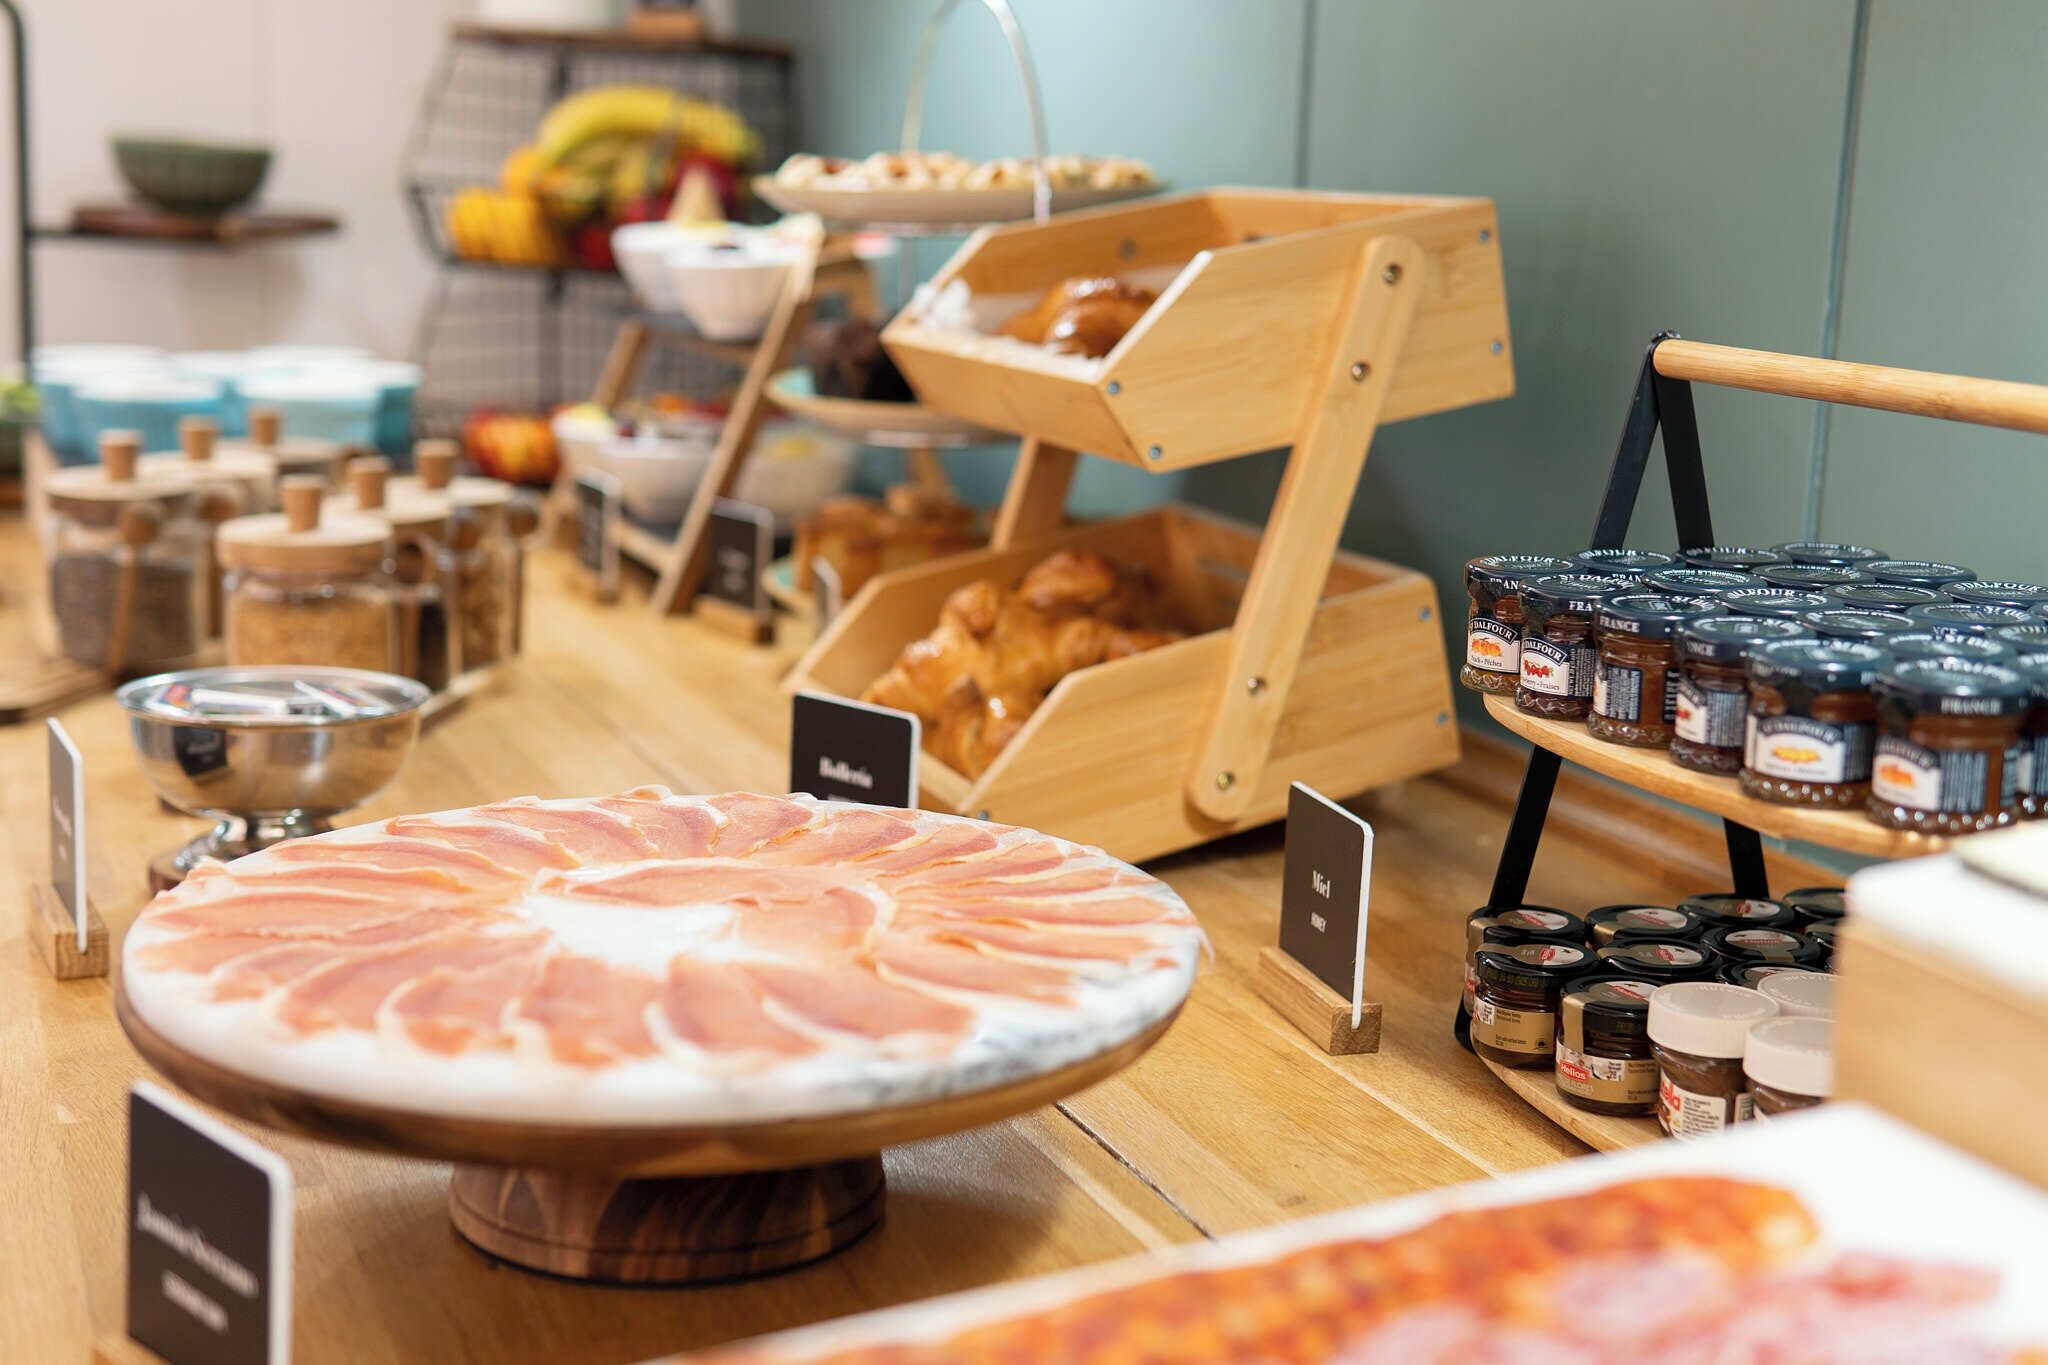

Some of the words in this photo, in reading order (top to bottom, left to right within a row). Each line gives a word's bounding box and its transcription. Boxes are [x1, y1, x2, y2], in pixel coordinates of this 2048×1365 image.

[1473, 620, 1513, 641] DALFOUR
[1600, 615, 1640, 633] FRANCE
[1525, 640, 1562, 661] DALFOUR
[1312, 870, 1330, 899] Miel
[1560, 1062, 1587, 1081] Helios
